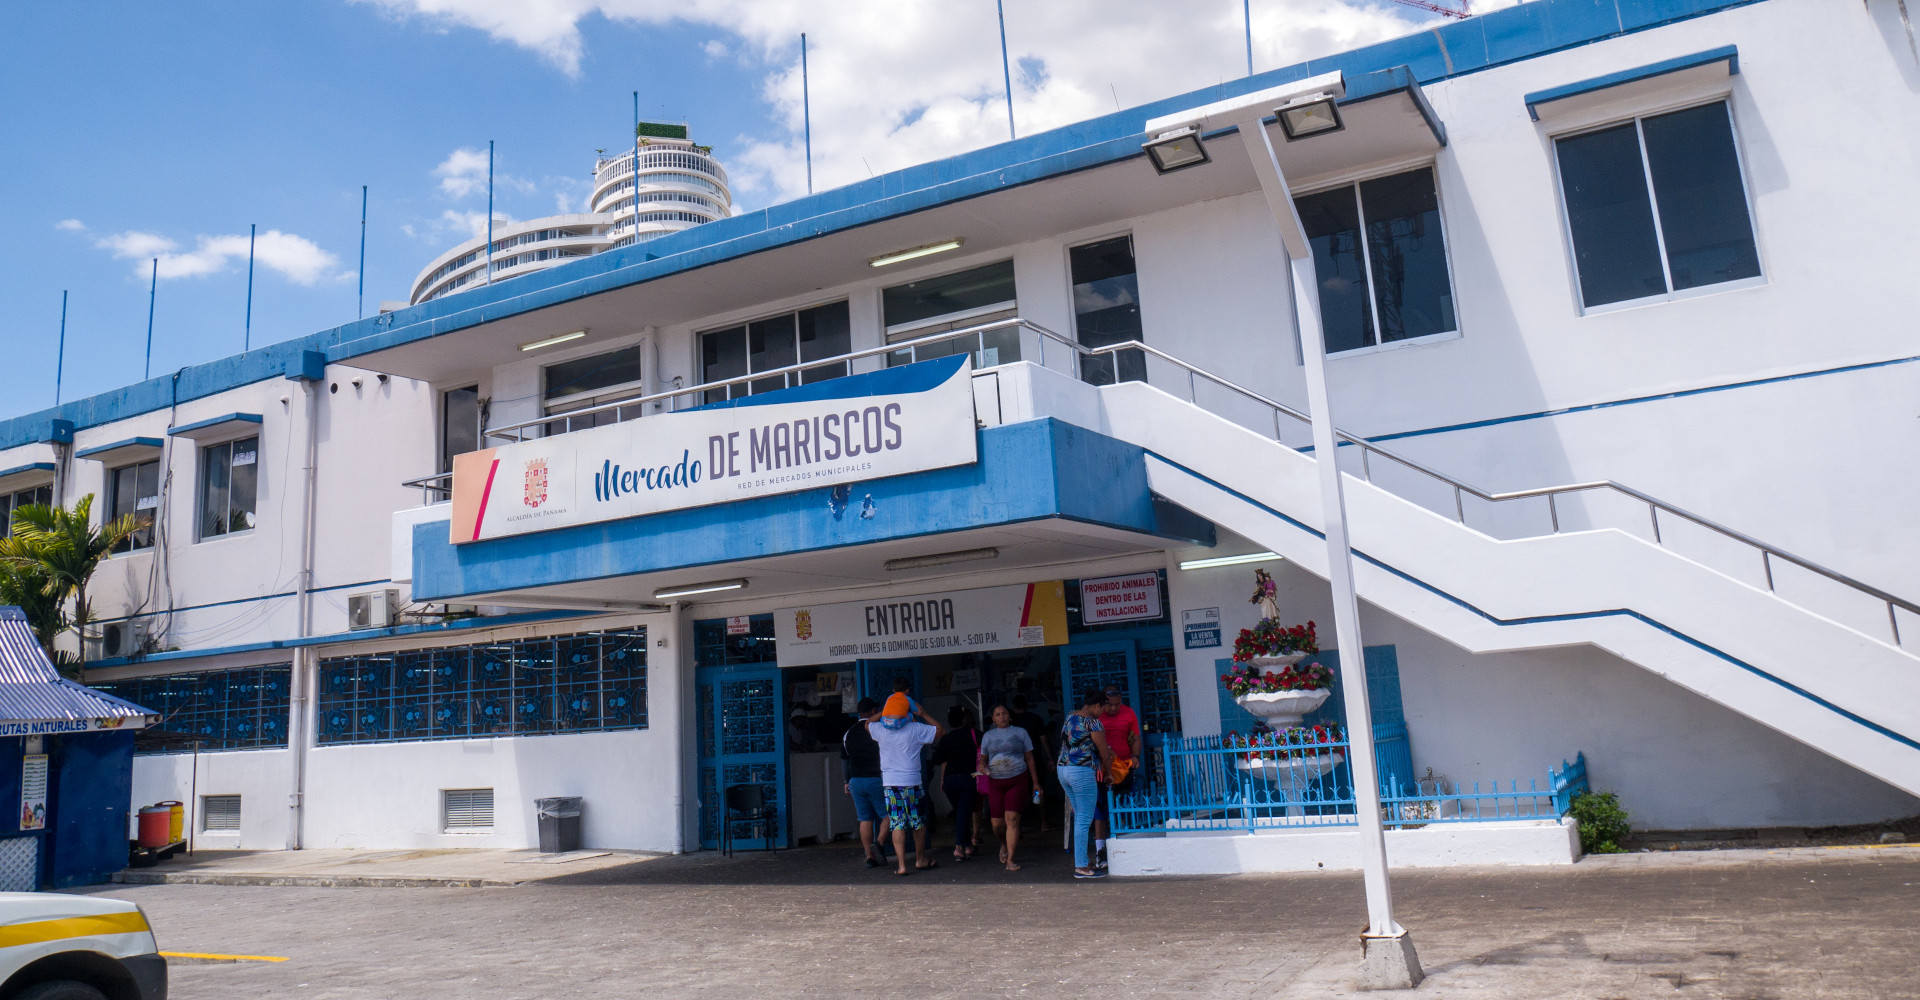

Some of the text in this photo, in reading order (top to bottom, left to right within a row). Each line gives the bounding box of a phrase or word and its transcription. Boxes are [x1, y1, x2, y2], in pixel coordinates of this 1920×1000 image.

[595, 402, 902, 502] Mercado DE MARISCOS
[737, 462, 872, 489] RED DE MERCADOS MUNICIPALES
[1084, 577, 1155, 594] PROHIBIDO ANIMALES
[1095, 591, 1147, 605] DENTRO DE LAS
[864, 598, 955, 637] ENTRADA
[1096, 604, 1148, 618] INSTALACIONES
[1188, 637, 1218, 647] AMBULANTE
[1197, 631, 1214, 639] VENTA
[829, 644, 860, 657] HORARIO:
[860, 642, 880, 654] LUNES
[882, 641, 887, 652] A
[888, 639, 919, 651] DOMINGO
[920, 638, 929, 649] DE
[929, 636, 945, 648] 5:00
[946, 635, 962, 647] A.M.
[967, 633, 984, 645] 5:00
[985, 631, 1000, 644] P.M.
[820, 676, 832, 692] 34
[31, 719, 88, 733] NATURALES
